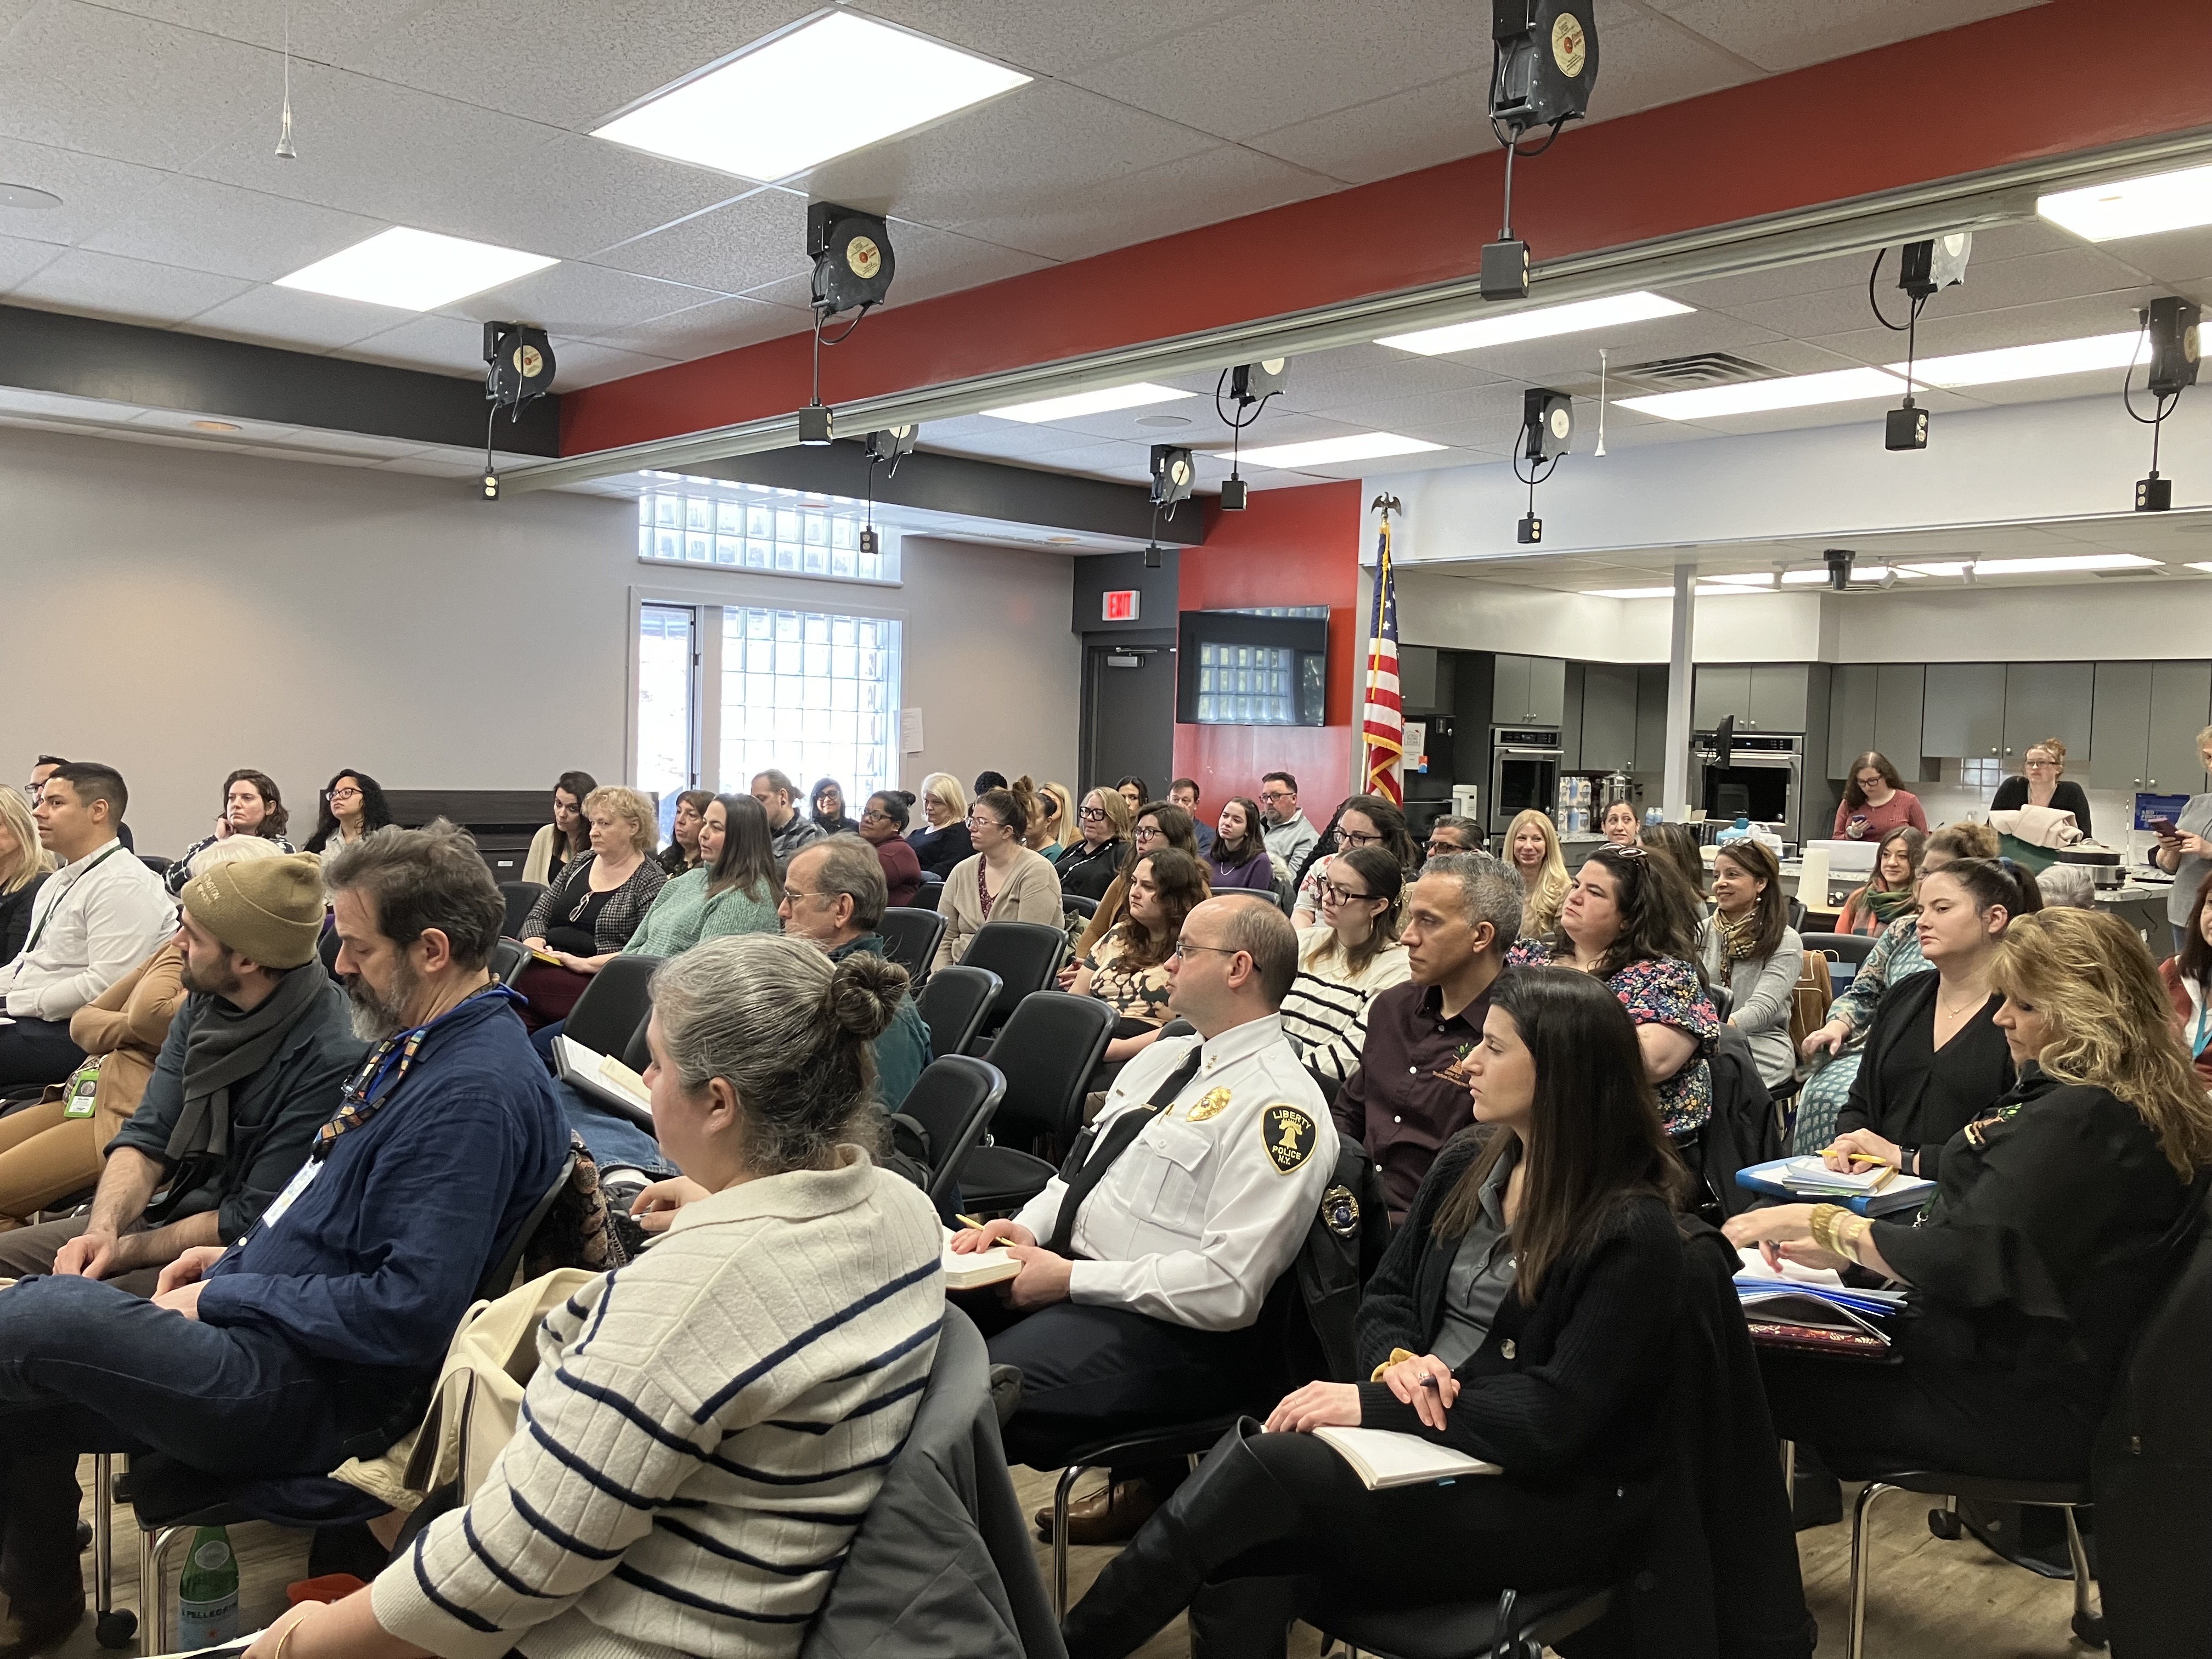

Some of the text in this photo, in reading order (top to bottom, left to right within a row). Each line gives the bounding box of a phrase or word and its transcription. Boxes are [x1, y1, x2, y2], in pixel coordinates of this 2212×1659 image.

[1108, 592, 1132, 618] EXIT
[1272, 1110, 1312, 1129] LIBERTY
[1272, 1145, 1302, 1160] POLICE
[1278, 1154, 1291, 1165] N.Y.
